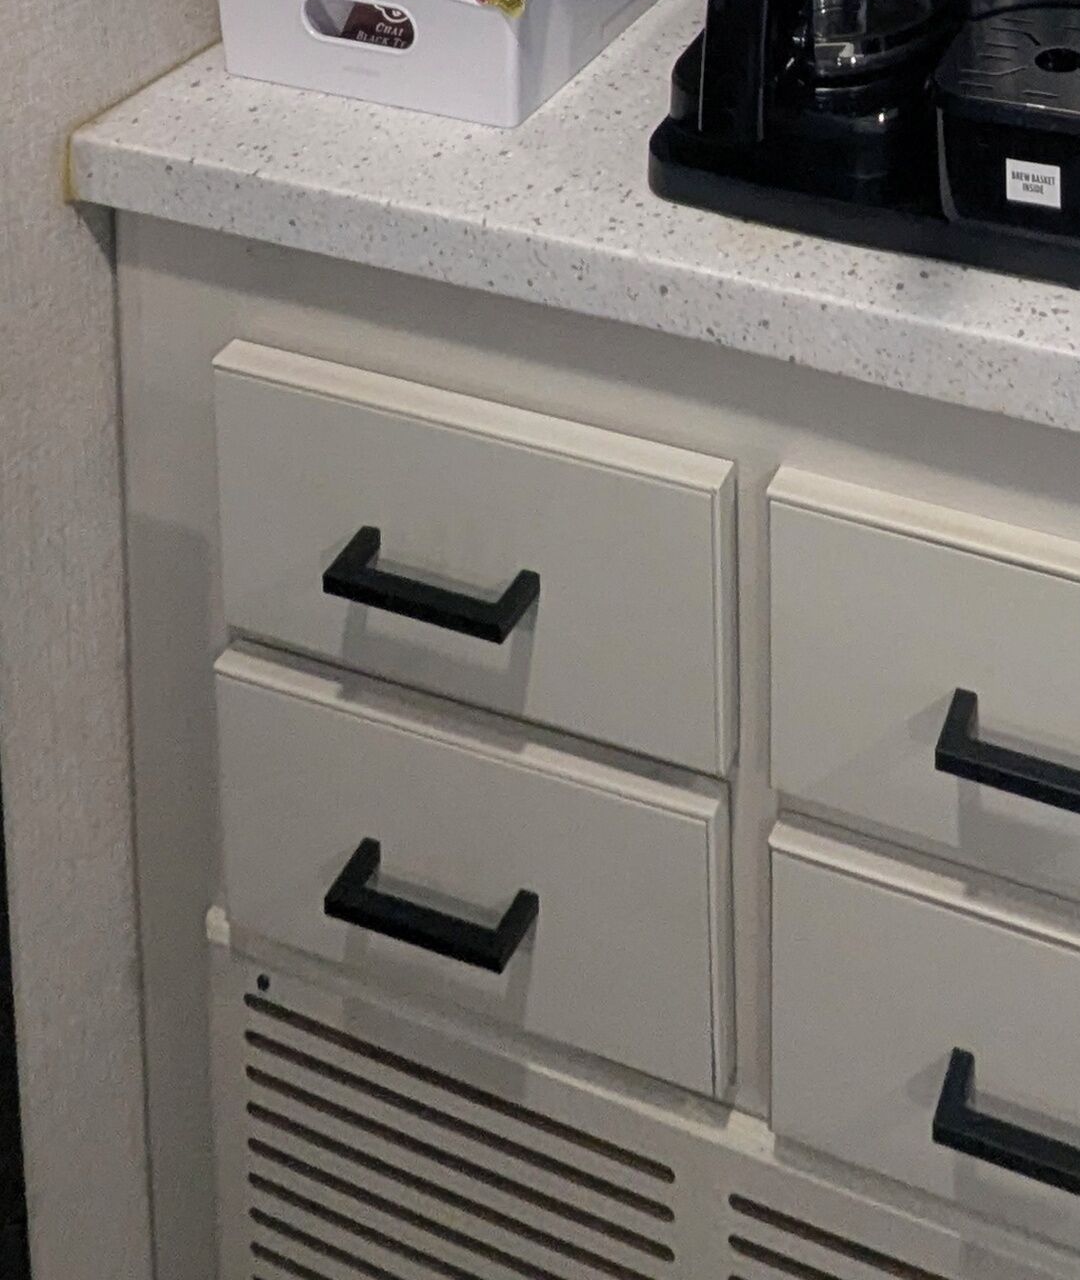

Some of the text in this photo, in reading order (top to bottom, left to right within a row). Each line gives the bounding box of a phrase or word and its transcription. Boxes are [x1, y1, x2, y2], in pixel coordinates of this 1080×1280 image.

[356, 30, 389, 45] BLACK
[1011, 171, 1056, 185] BREW BASKET
[1022, 183, 1044, 195] INSIDE
